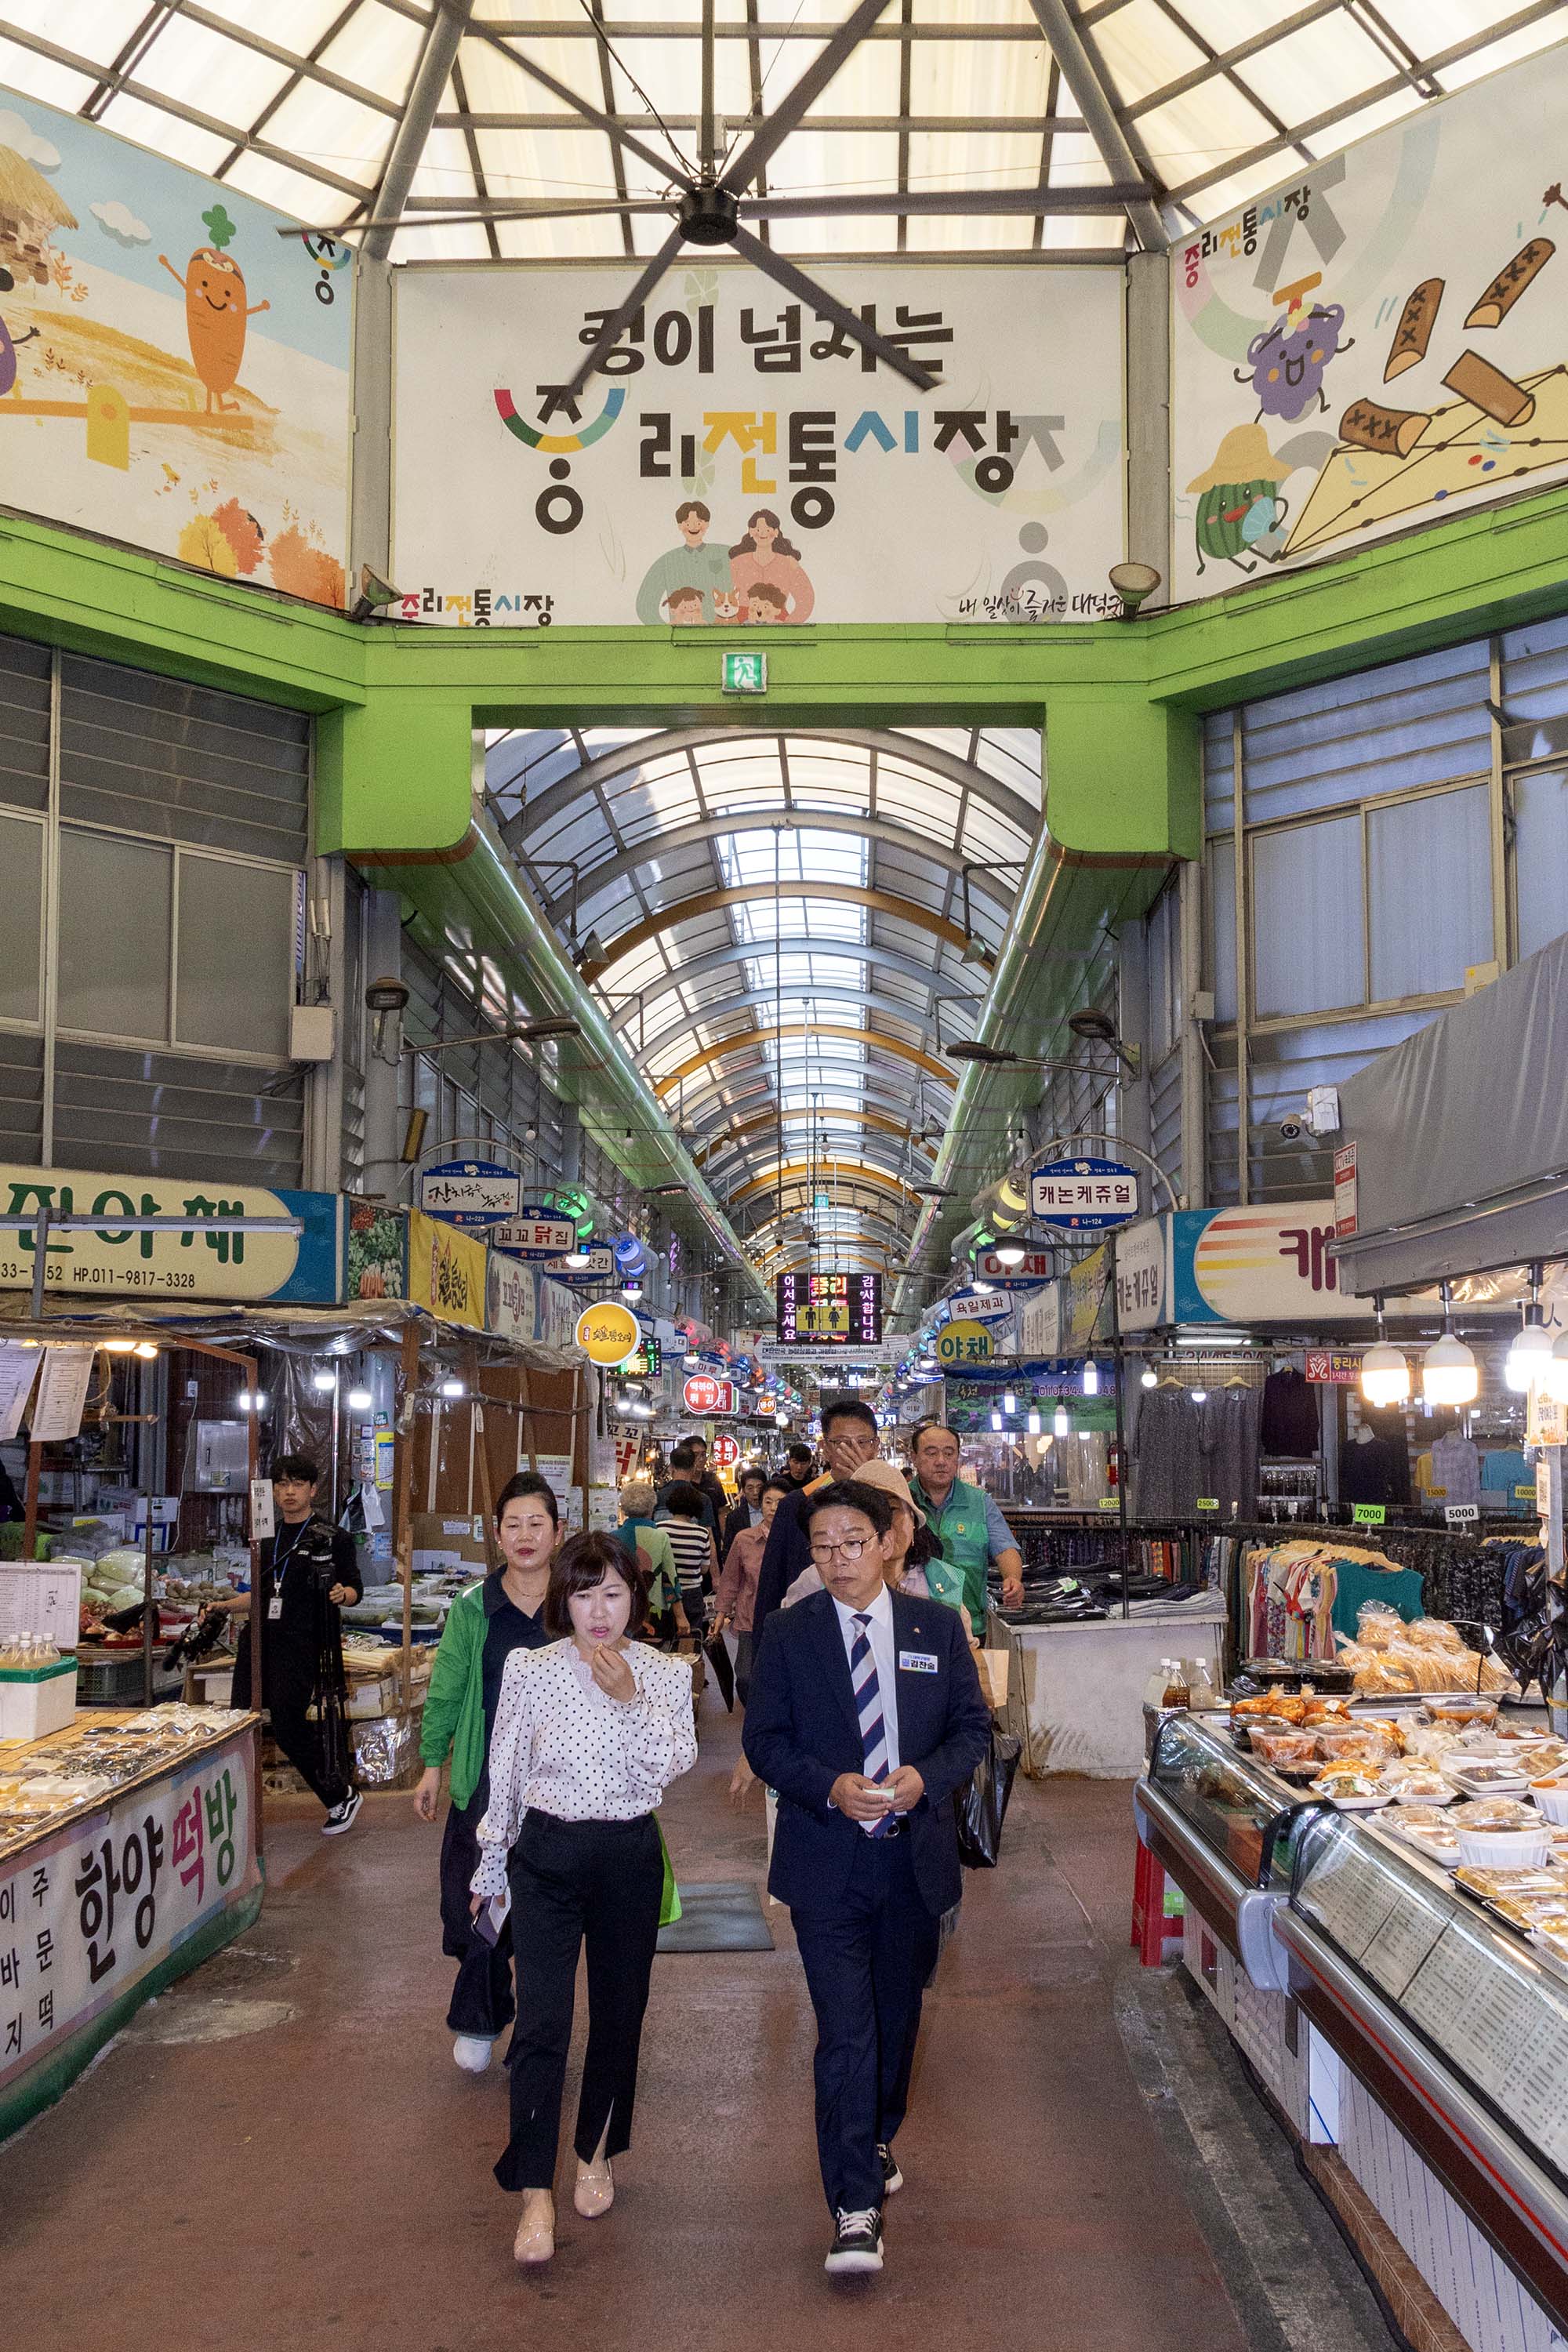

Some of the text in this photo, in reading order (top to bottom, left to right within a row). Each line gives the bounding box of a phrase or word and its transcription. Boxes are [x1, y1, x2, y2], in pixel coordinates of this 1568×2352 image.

[1185, 185, 1312, 288] 중리전통시장
[579, 304, 714, 376] 정이
[494, 383, 1019, 535] 중리전통시장
[959, 595, 977, 615] 내
[983, 595, 1019, 620] 일상이
[1024, 590, 1068, 622] 즐거운
[429, 1182, 483, 1204] 잔치국수
[1040, 1185, 1130, 1204] 캐논케쥬얼
[1, 1263, 195, 1288] 33-152 HP.011-9817-3328
[784, 1275, 797, 1340] 어서오세요
[862, 1276, 875, 1341] 감사합니다
[956, 1297, 1004, 1314] 육일제과
[941, 1336, 989, 1359] 야채
[1333, 1356, 1363, 1370] 중리시
[689, 1381, 715, 1392] 떡볶이
[689, 1393, 714, 1405] 튀김
[1357, 1508, 1381, 1519] 7000
[1449, 1508, 1475, 1519] 5000
